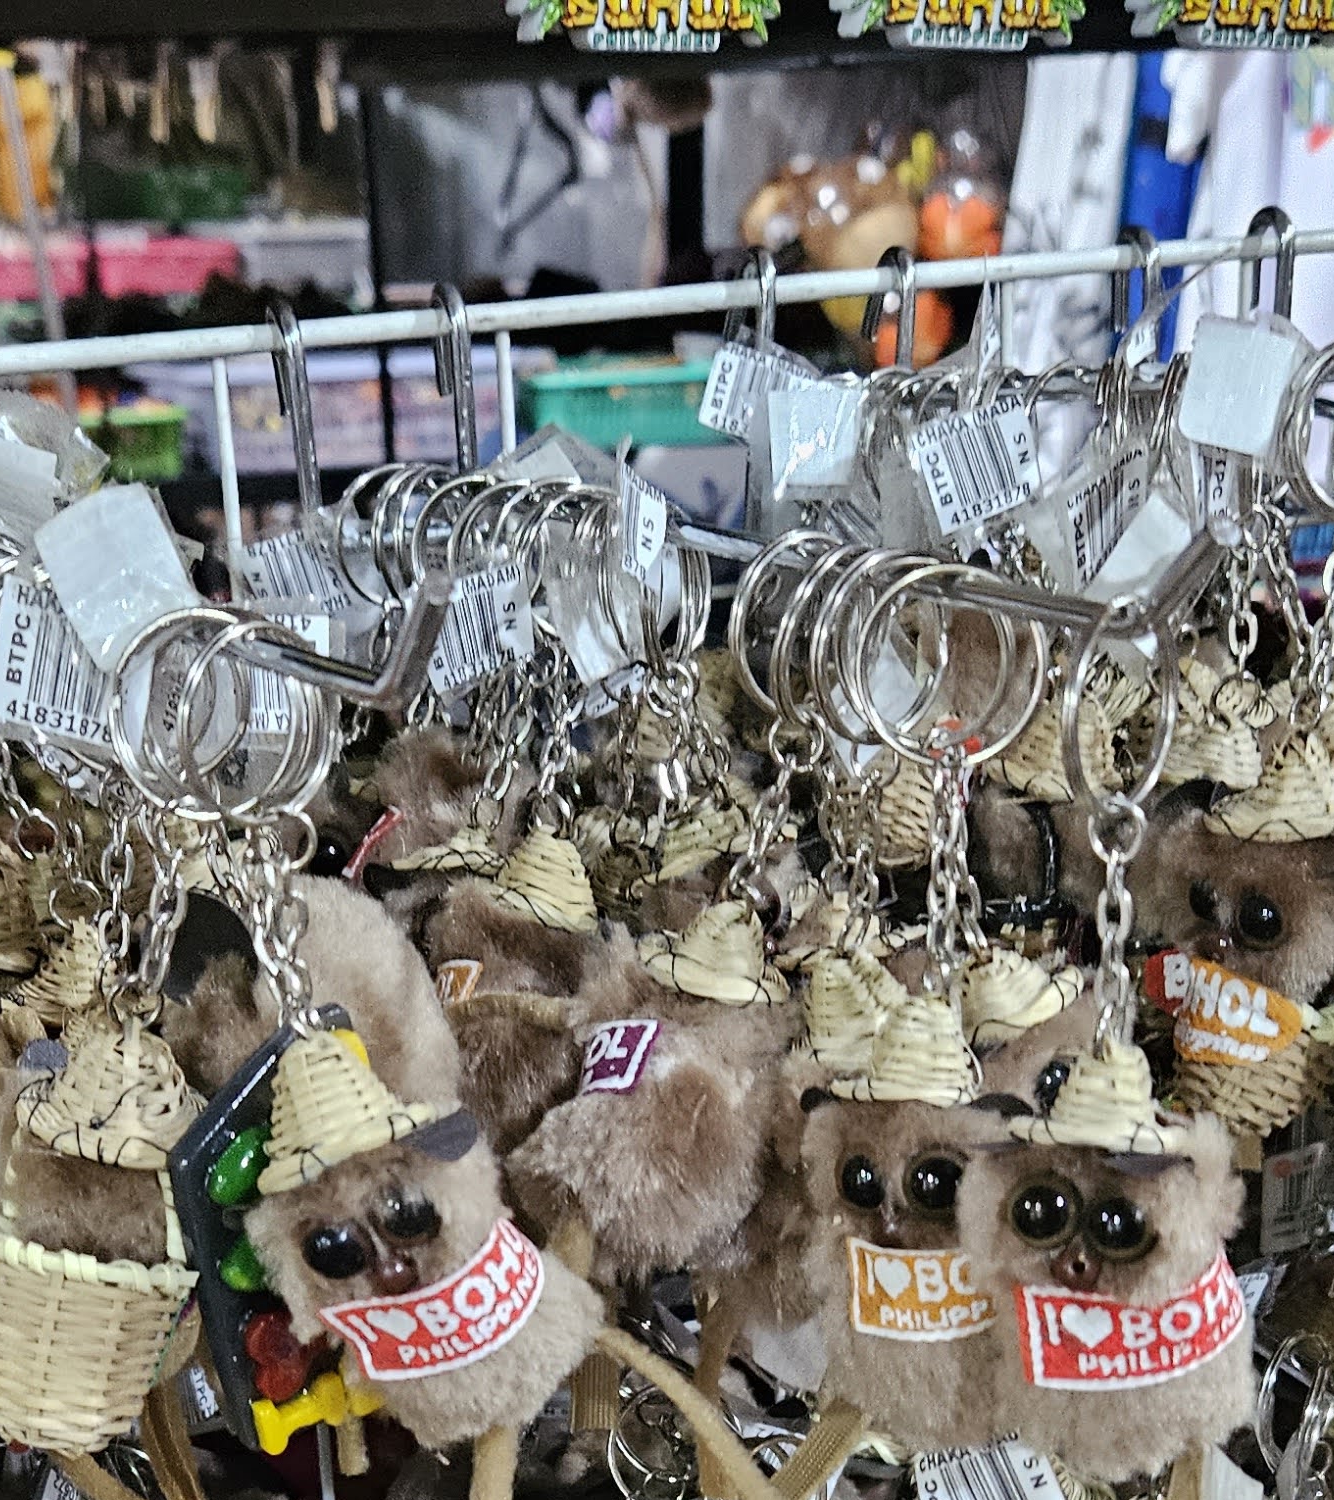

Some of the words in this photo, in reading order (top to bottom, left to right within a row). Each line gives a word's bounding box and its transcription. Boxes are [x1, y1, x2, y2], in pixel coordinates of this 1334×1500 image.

[711, 358, 733, 410] BTPC
[1013, 432, 1027, 446] S
[1019, 451, 1031, 466] N
[927, 451, 954, 507] BTPC
[950, 482, 1032, 527] 41831878
[502, 601, 516, 616] S
[504, 617, 518, 632] N
[5, 612, 32, 686] BTPC
[347, 1313, 379, 1343] I
[1043, 1301, 1062, 1347] I
[1023, 1455, 1041, 1470] S
[1031, 1474, 1049, 1489] N
